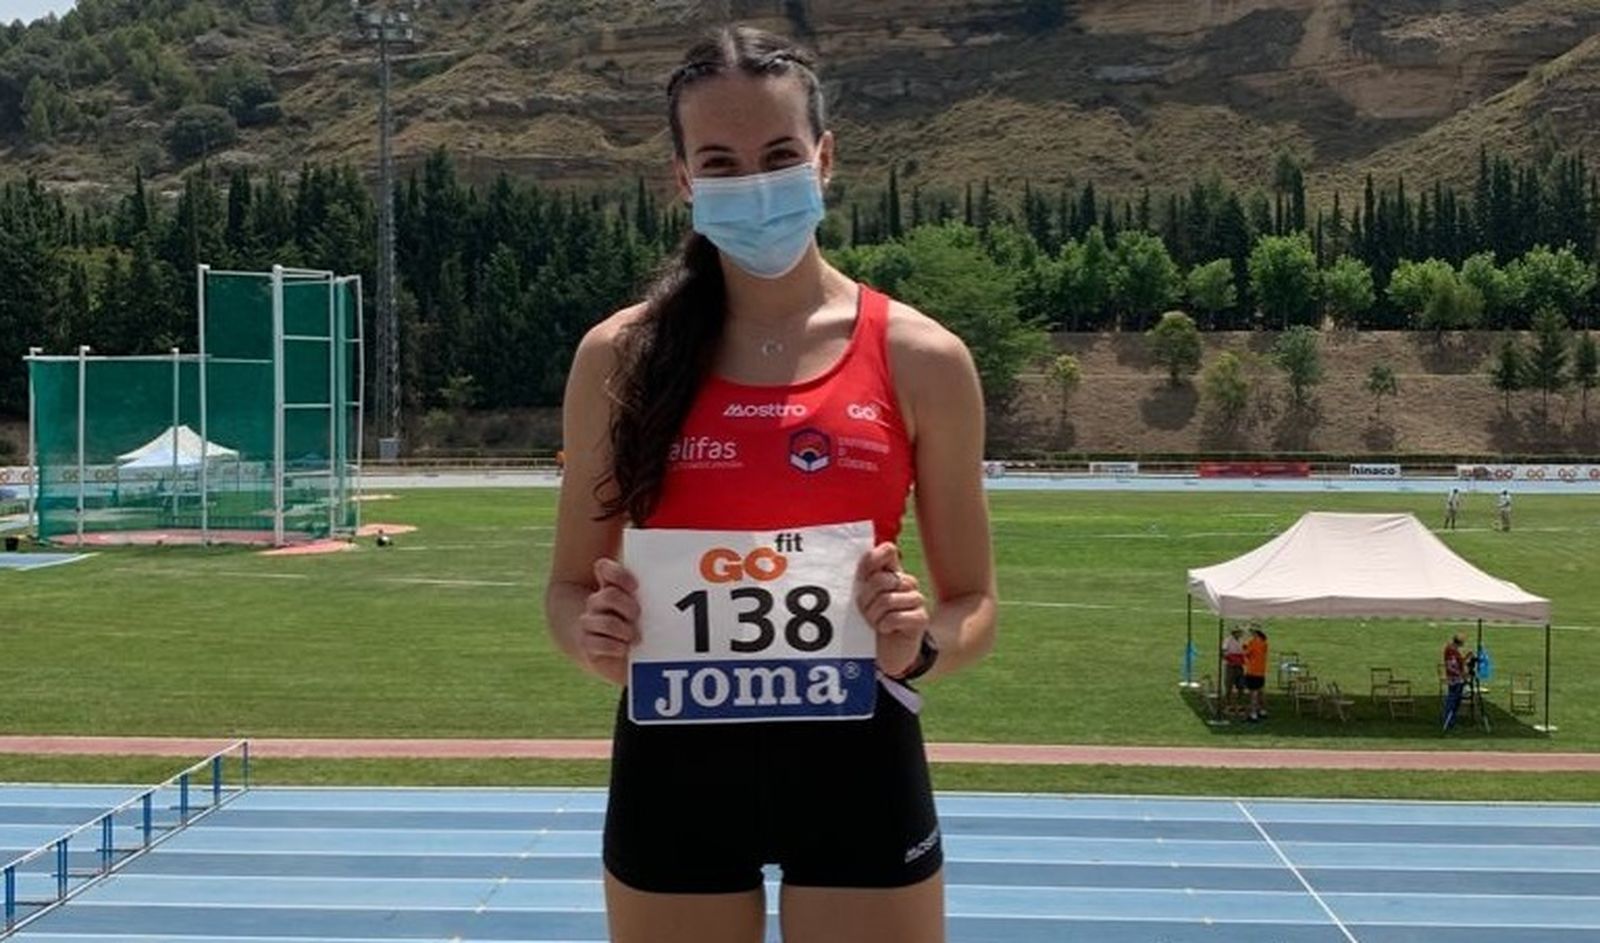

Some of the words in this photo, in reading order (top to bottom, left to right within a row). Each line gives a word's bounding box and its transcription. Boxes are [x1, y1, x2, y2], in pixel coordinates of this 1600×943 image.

[668, 436, 737, 461] alifas
[700, 547, 788, 583] GO
[774, 533, 804, 552] fit
[674, 585, 833, 653] 138
